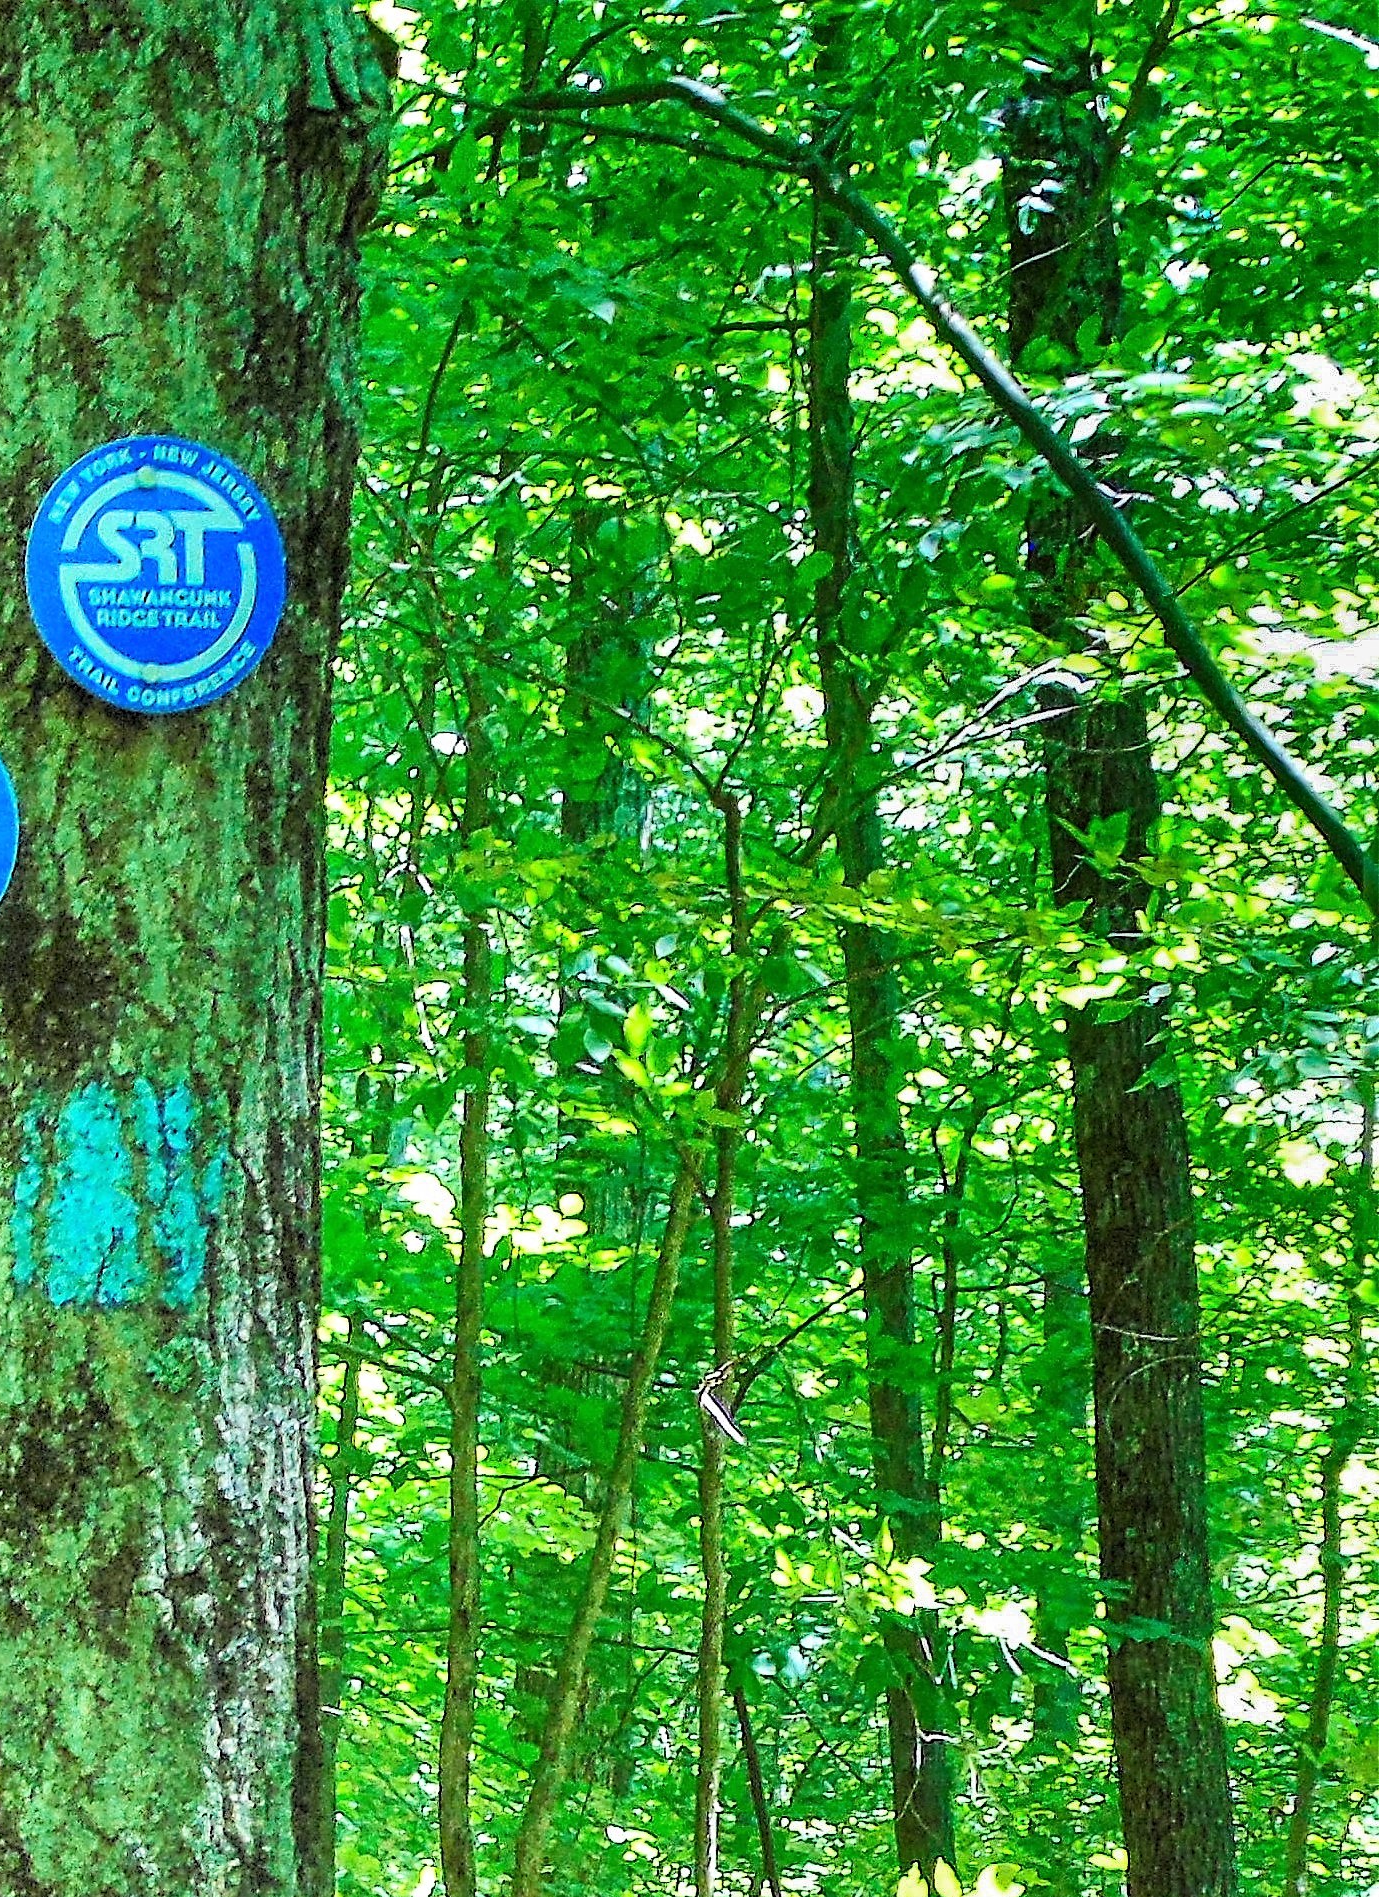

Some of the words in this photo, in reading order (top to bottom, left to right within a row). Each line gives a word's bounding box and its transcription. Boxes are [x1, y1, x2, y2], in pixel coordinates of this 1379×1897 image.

[79, 446, 133, 484] YORK
[153, 445, 199, 467] NEW
[80, 509, 240, 586] SRT
[97, 609, 159, 628] RIDGE
[162, 610, 221, 629] TRAIL
[68, 644, 119, 696] TRAIL
[126, 640, 257, 707] CONFERENCE
